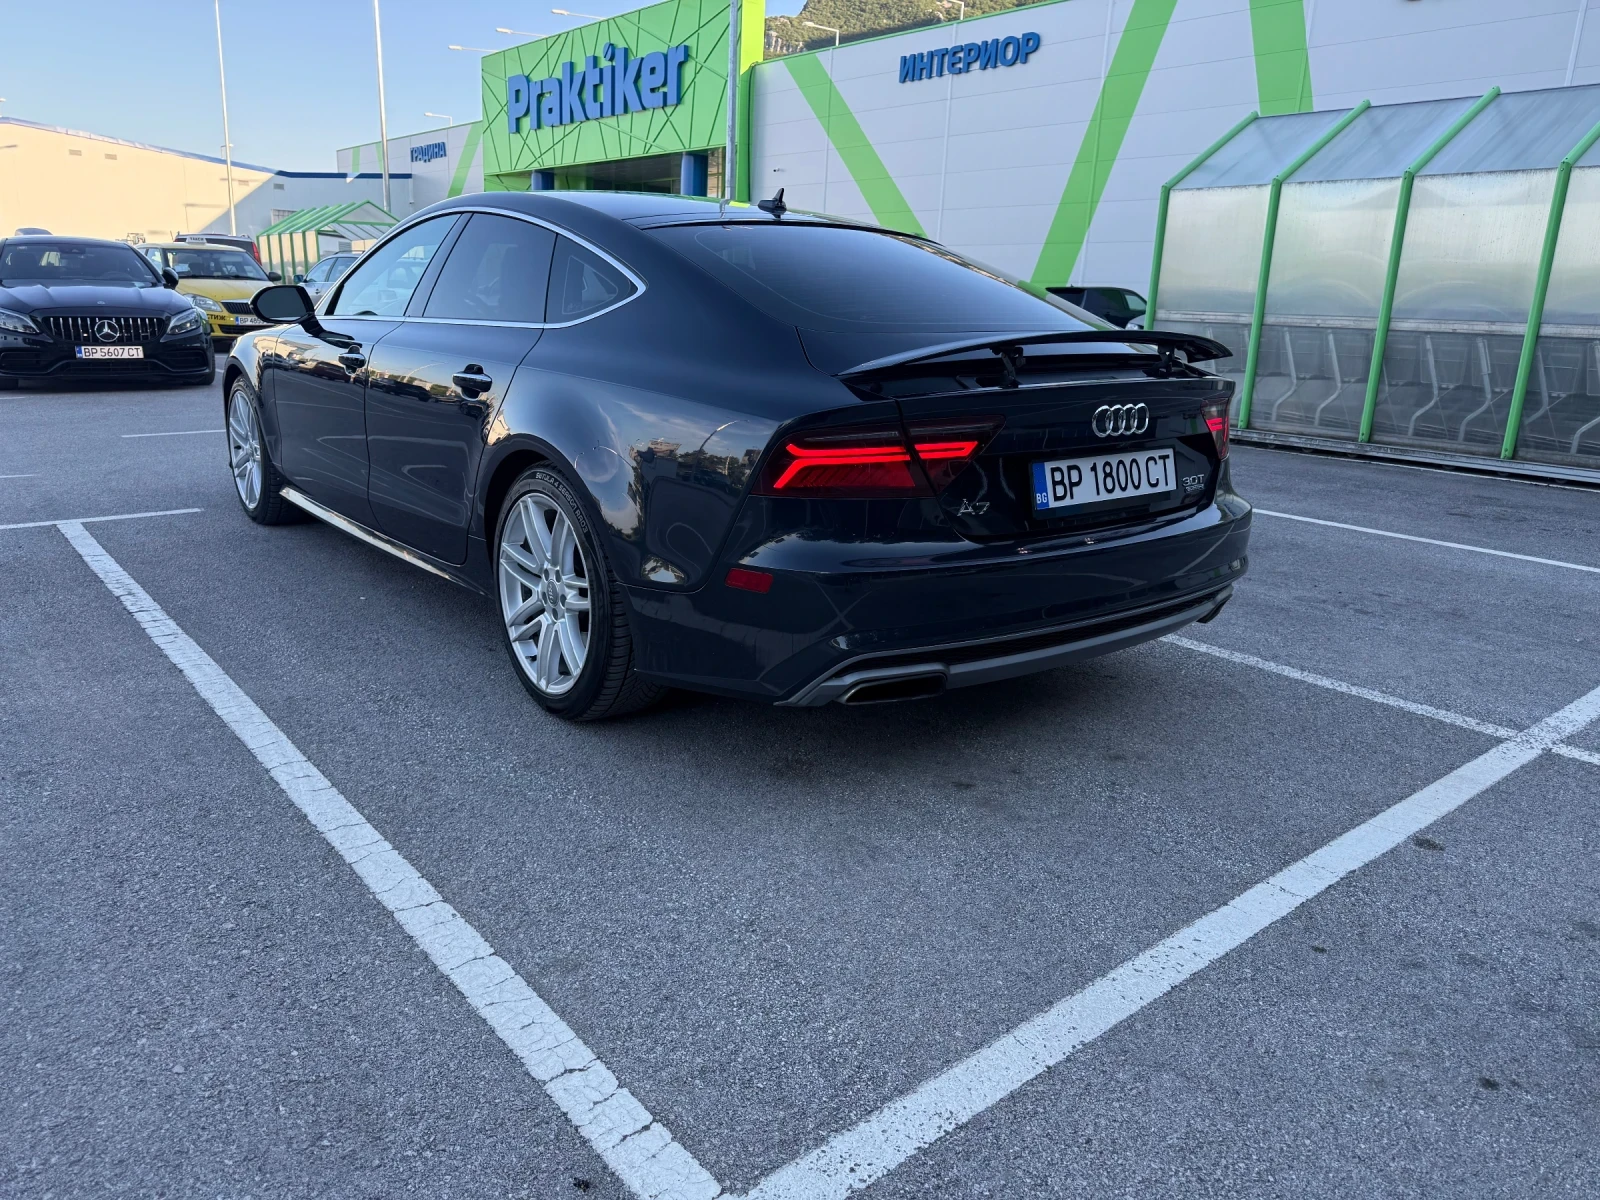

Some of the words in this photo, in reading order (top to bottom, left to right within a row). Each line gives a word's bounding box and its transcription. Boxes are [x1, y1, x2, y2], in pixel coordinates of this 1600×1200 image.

[899, 32, 1041, 83] ИНТЕРИОР
[508, 42, 689, 134] Praktiker
[410, 141, 447, 163] ГРАДИНА
[84, 347, 98, 357] BP
[100, 347, 125, 357] 5607
[127, 347, 140, 357] CT
[1050, 464, 1082, 502] BP
[1090, 458, 1141, 496] 1800
[1145, 454, 1170, 488] CT
[957, 499, 991, 516] A7
[1036, 492, 1048, 504] BG
